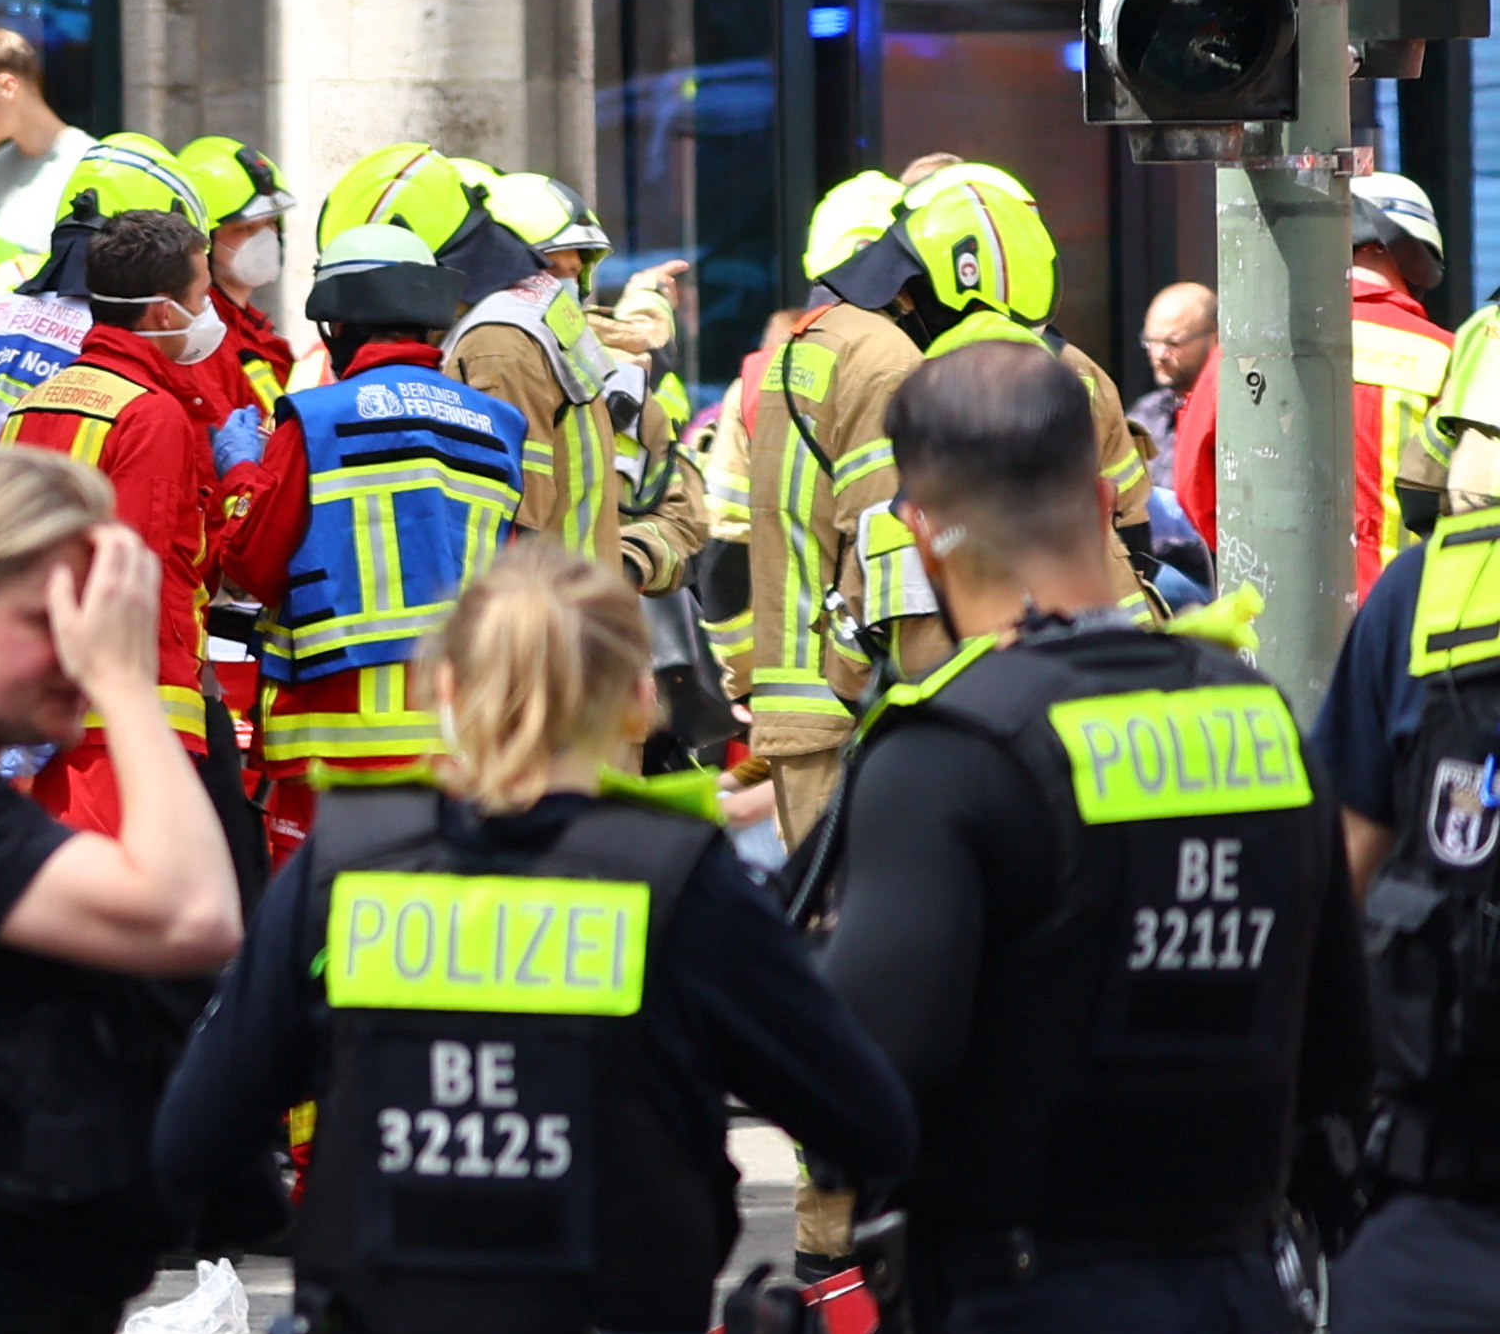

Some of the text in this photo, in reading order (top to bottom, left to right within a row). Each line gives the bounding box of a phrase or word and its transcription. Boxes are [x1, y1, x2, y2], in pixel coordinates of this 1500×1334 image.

[8, 313, 87, 349] FEUERWE
[18, 299, 85, 323] BERLINER
[397, 382, 463, 407] BERLINER
[403, 398, 494, 435] FEUERWEHR
[1080, 707, 1300, 800] POLIZEI
[1176, 838, 1243, 904] BE
[346, 898, 626, 990] POLIZEI
[1126, 908, 1275, 971] 32117
[429, 1040, 520, 1109] BE
[376, 1108, 573, 1180] 32125
